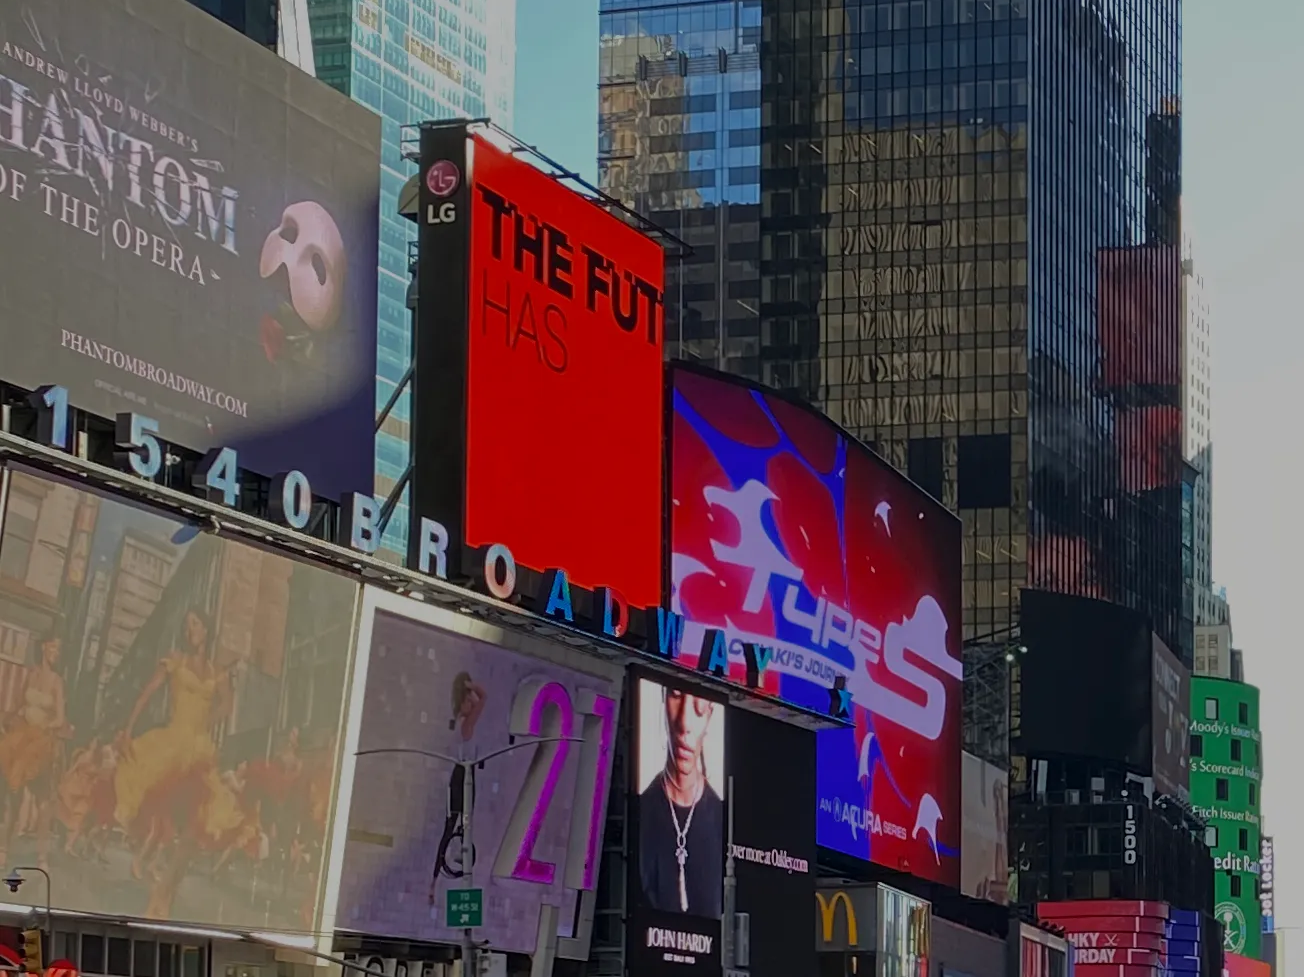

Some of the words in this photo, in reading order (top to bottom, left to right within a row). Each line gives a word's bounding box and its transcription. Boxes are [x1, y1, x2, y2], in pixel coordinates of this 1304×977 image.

[2, 41, 69, 84] ANDREW
[74, 77, 124, 114] LLOYD
[129, 106, 199, 153] WEBBER'S
[40, 181, 101, 237] THE
[112, 218, 206, 286] OPERA
[427, 202, 456, 224] LG
[475, 182, 574, 300] THE
[482, 268, 569, 375] HAS
[61, 328, 249, 418] PHANTOMBROADWAY.COM
[1199, 760, 1244, 776] Scorecard
[820, 797, 832, 813] AN
[841, 802, 882, 837] ACURA
[882, 820, 907, 841] SERIES
[1124, 805, 1137, 865] 1500
[1219, 807, 1245, 821] Issuer
[745, 847, 764, 864] more
[647, 926, 676, 948] JOHN
[676, 931, 713, 954] HARDY
